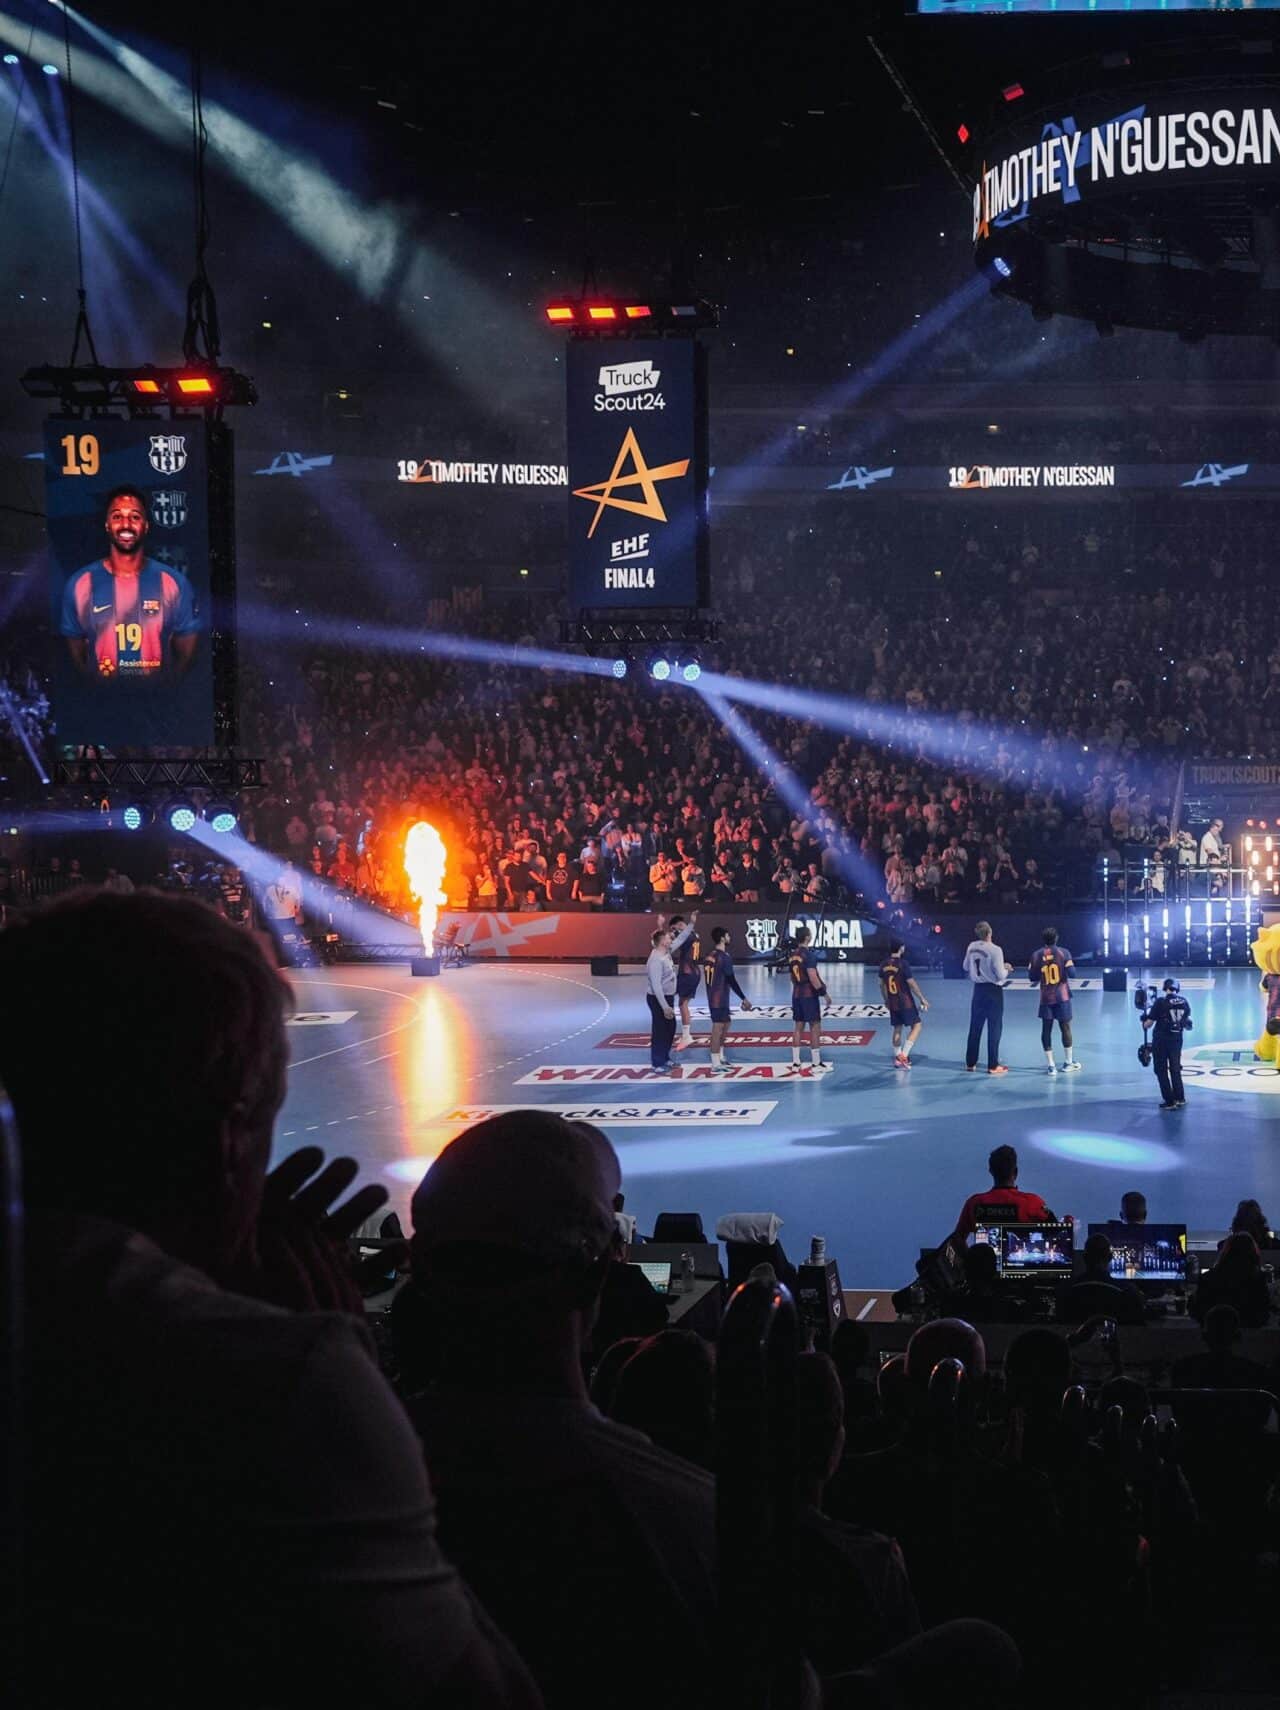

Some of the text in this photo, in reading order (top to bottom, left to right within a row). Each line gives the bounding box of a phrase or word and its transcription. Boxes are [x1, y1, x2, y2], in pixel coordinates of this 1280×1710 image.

[983, 131, 1081, 223] TIMOTHEY
[606, 368, 653, 387] Truck
[594, 393, 666, 412] Scout24
[61, 434, 99, 475] 19
[397, 460, 568, 486] 19 TIMOTHEY N'GUESSA
[949, 466, 1114, 488] 19 TIMOTHEY N'GUESSAN
[611, 533, 650, 558] EHF
[605, 568, 655, 588] FINAL4
[116, 623, 142, 651] 19
[888, 975, 897, 994] 6
[1041, 963, 1060, 985] 10
